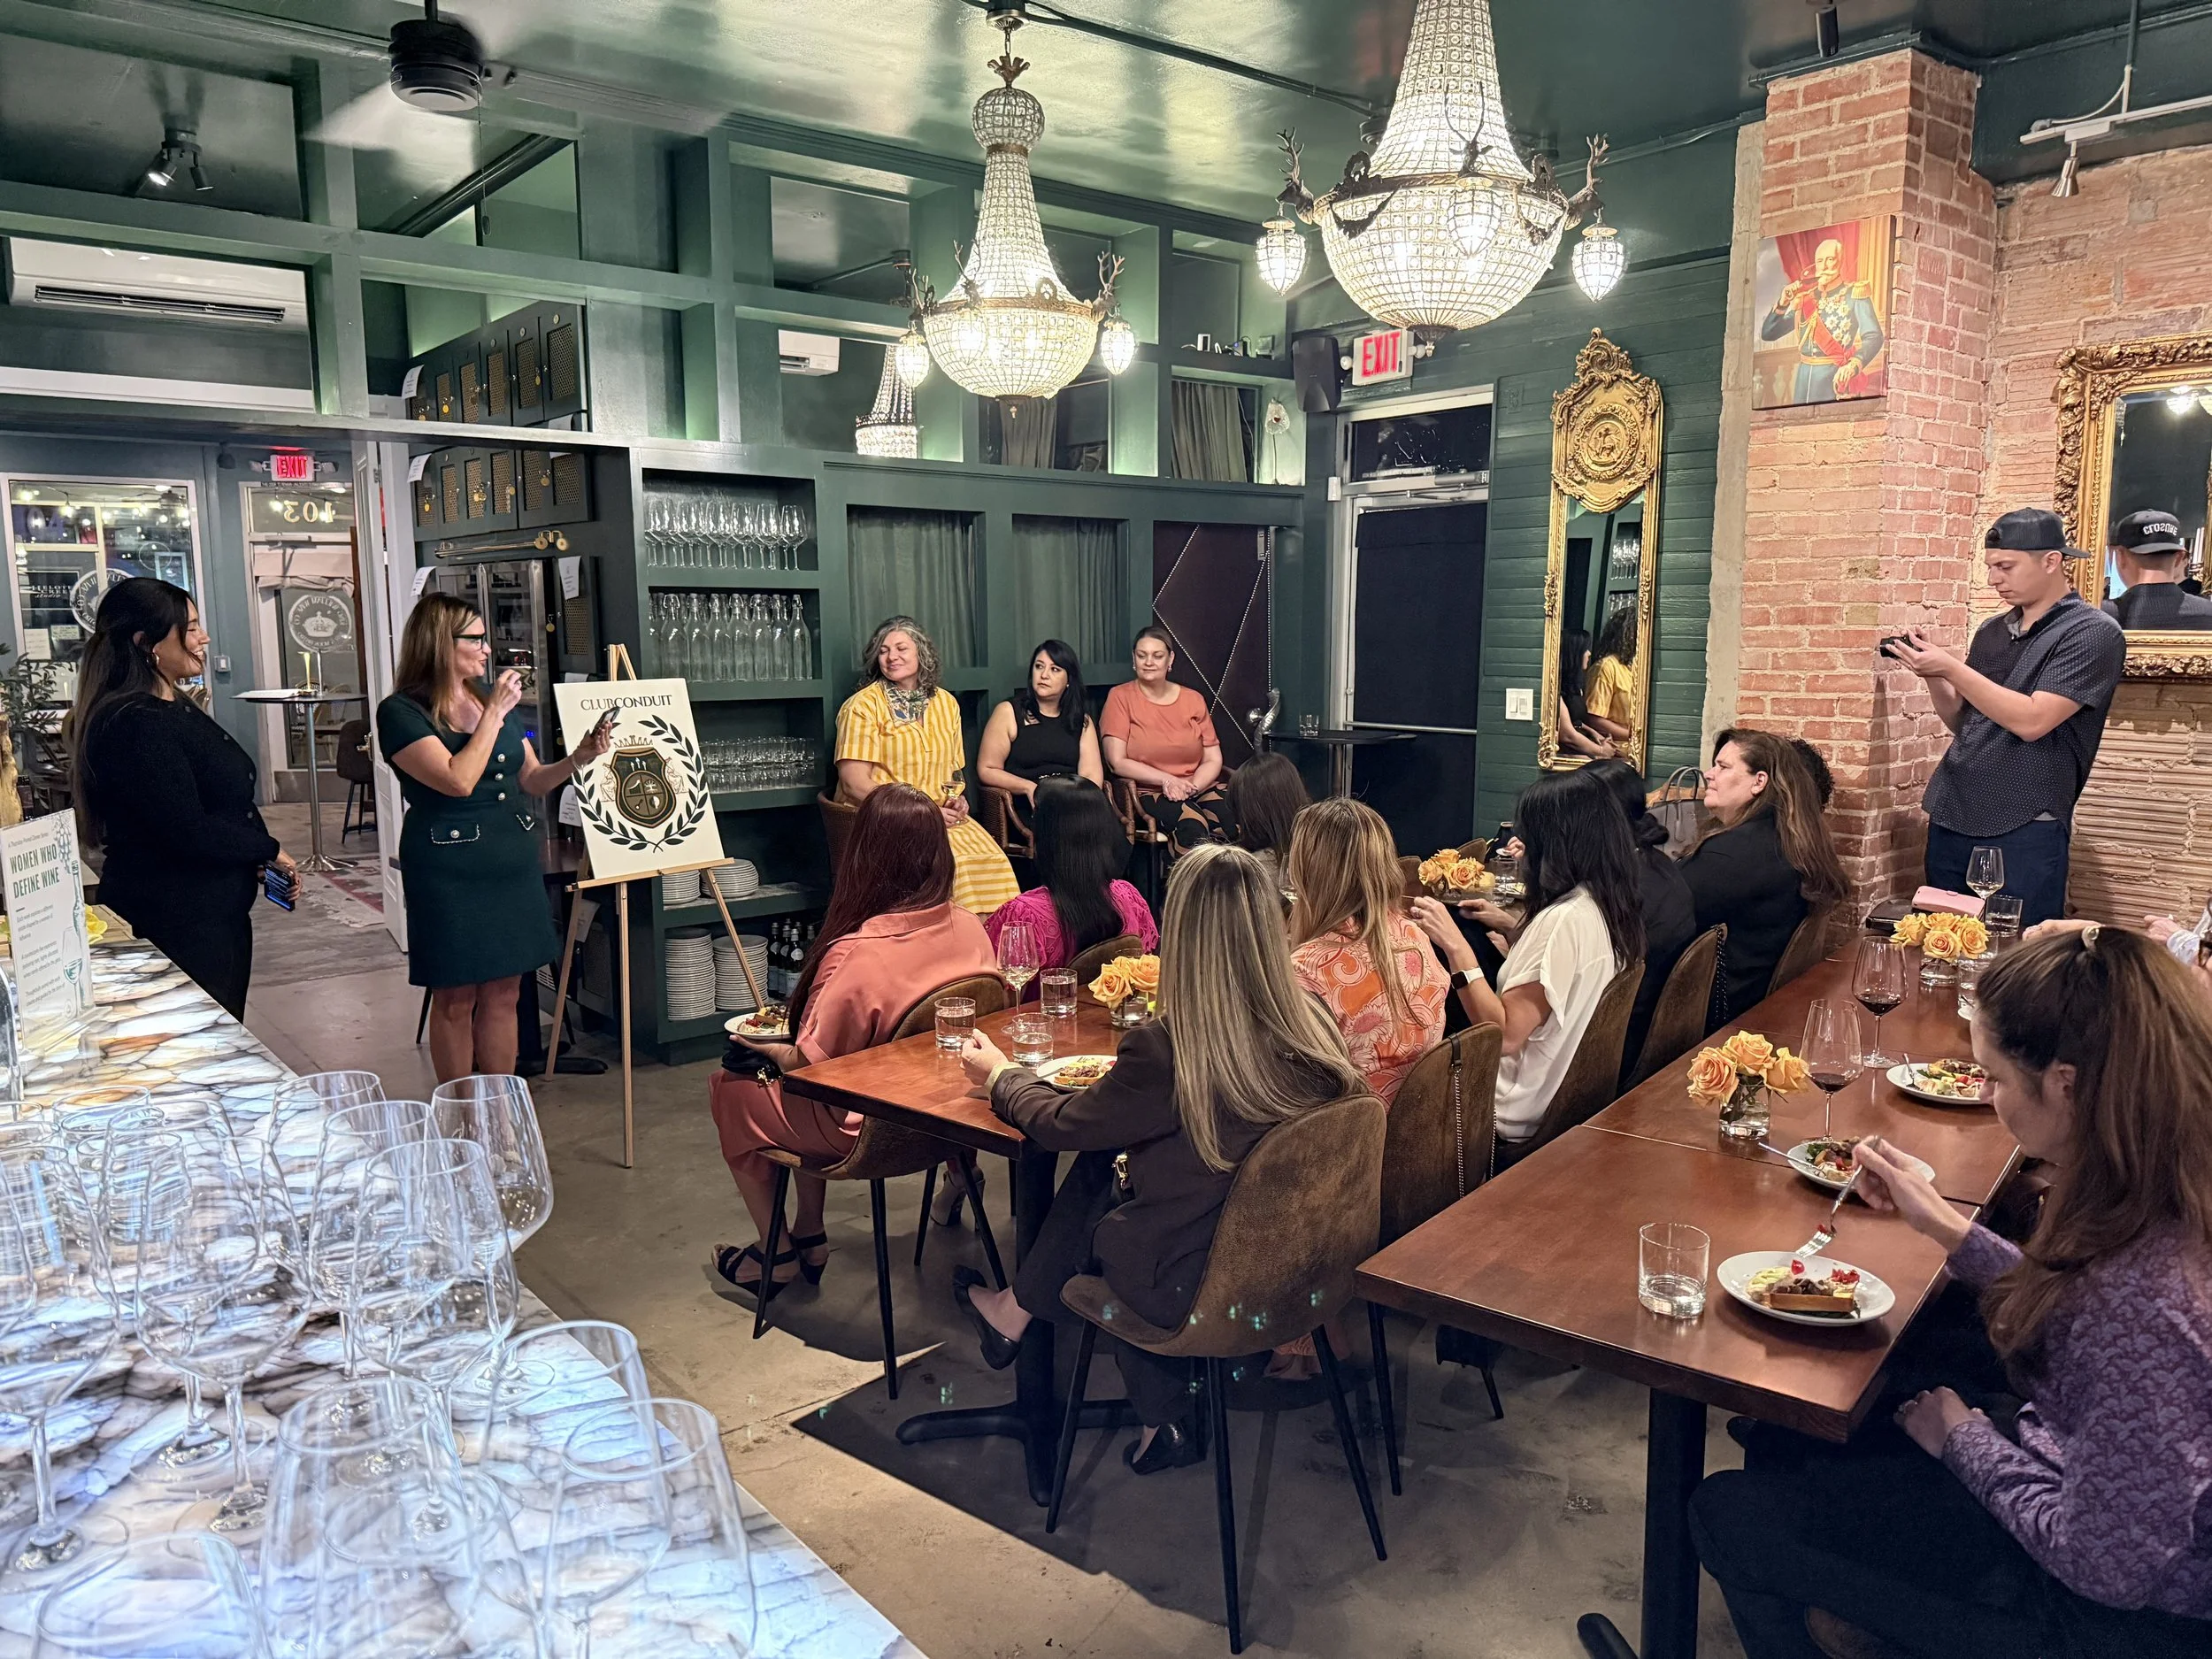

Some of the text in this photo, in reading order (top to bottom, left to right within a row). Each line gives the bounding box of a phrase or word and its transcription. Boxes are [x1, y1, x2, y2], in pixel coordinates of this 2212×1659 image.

[1361, 331, 1402, 378] EXIT
[276, 456, 308, 479] EXIT
[10, 843, 58, 874] WOMEN WHO
[12, 866, 60, 899] DEFINE WINE
